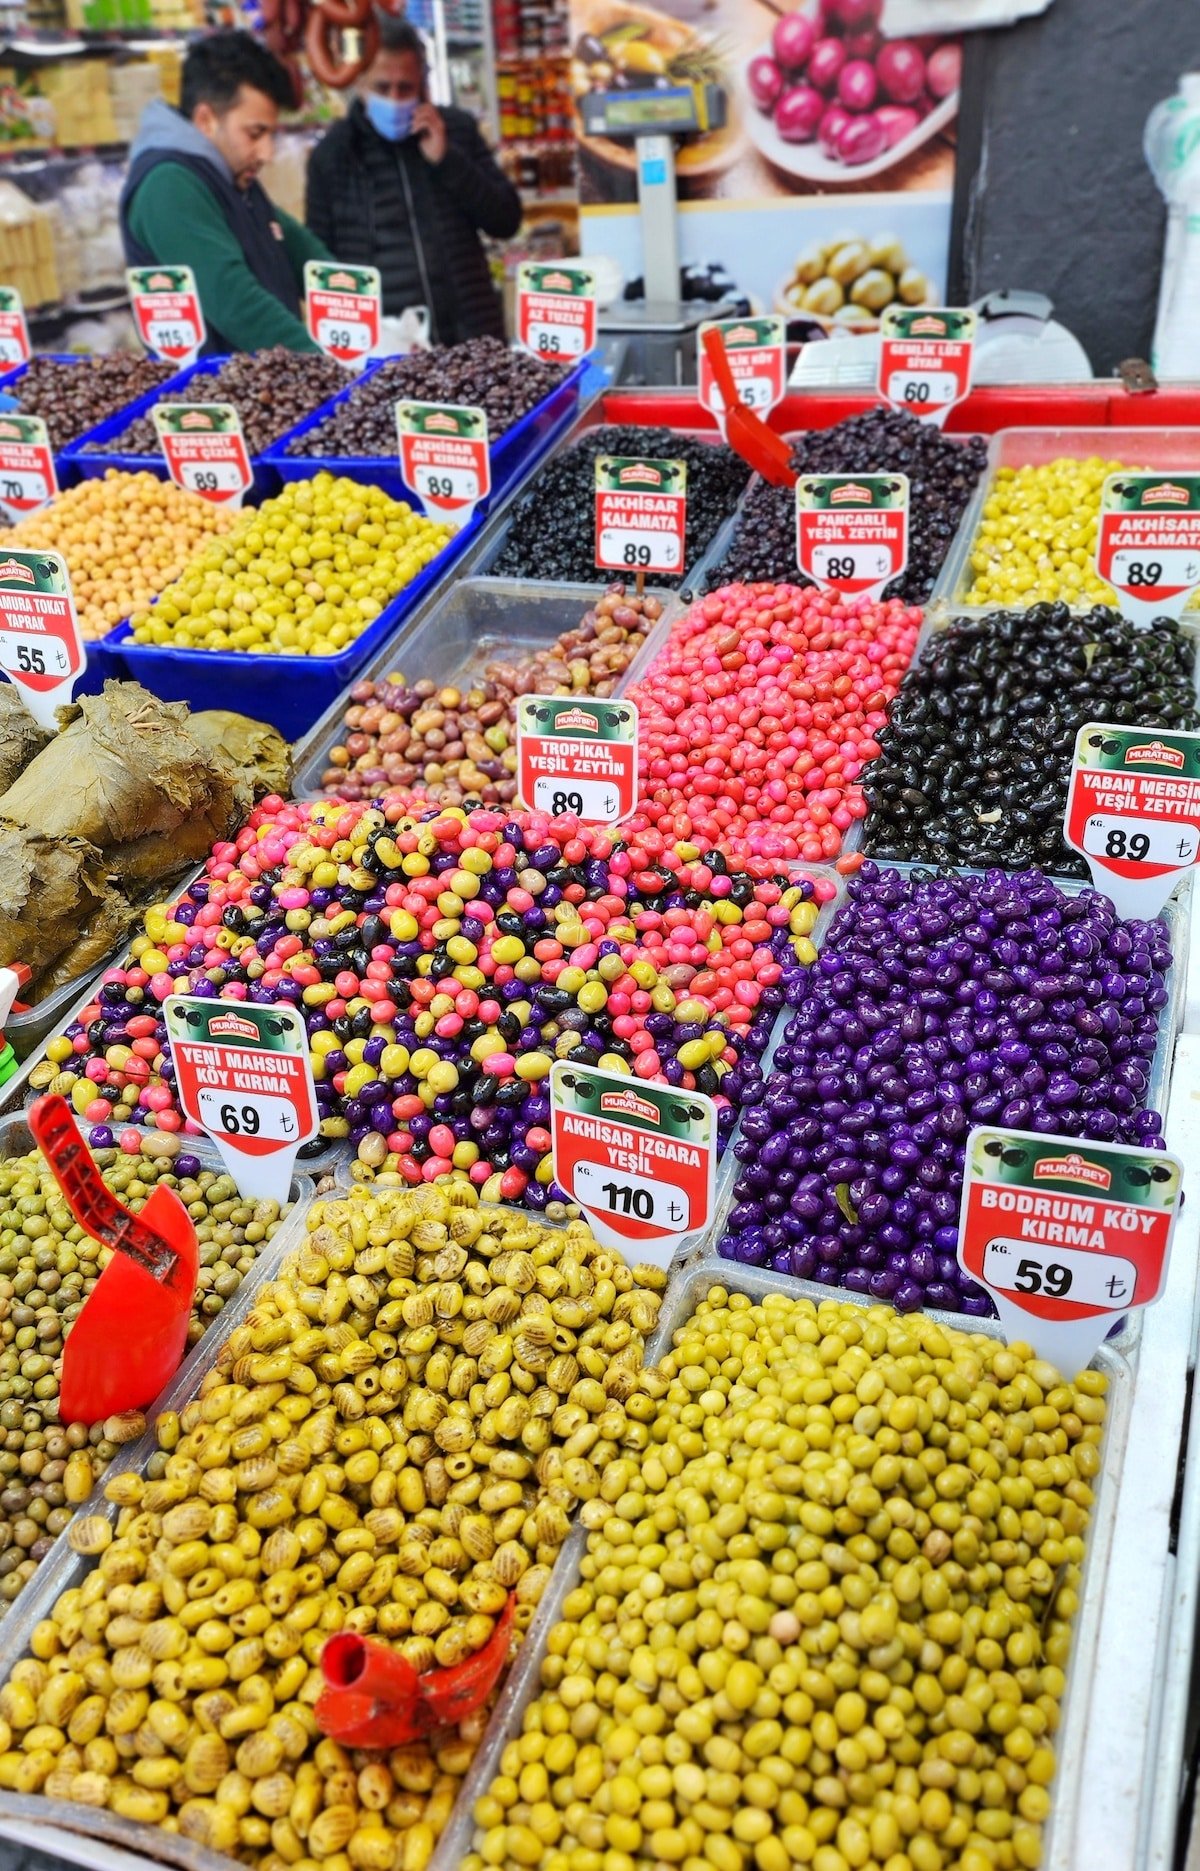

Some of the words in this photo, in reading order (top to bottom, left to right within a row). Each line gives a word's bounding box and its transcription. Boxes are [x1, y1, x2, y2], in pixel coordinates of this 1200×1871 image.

[158, 329, 184, 348] 115
[330, 329, 351, 350] 99
[538, 332, 560, 354] 85
[904, 381, 931, 403] 60
[2, 479, 23, 500] 70
[194, 471, 218, 491] 89
[427, 476, 453, 498] 89
[602, 495, 678, 513] AKHİSAR
[601, 512, 678, 530] KALAMATA
[817, 514, 888, 527] PANCARLI
[1118, 516, 1200, 532] AKHİSAR
[806, 525, 846, 543] YEŞİL
[848, 525, 899, 540] ZEYTİN
[1108, 532, 1200, 546] KALAMAT
[623, 543, 652, 567] 89
[827, 557, 856, 579] 89
[1127, 562, 1163, 587] 89
[33, 599, 66, 616] TOKAT
[5, 612, 46, 631] YAPRAK
[17, 645, 46, 675] 55
[540, 741, 613, 760] TROPİKAL
[1128, 749, 1181, 764] MURATBEY
[528, 755, 570, 774] YEŞİL
[573, 759, 625, 777] ZEYTİN
[1082, 774, 1136, 793] YABAN
[551, 791, 584, 818] 89
[1095, 791, 1140, 812] YEŞİL
[1090, 819, 1106, 828] KG.
[1105, 829, 1151, 862] 89
[211, 1022, 257, 1034] MURATBEY
[181, 1047, 222, 1066] YENİ
[225, 1052, 299, 1077] MAHSUL
[195, 1064, 229, 1086] KÖY
[233, 1071, 292, 1095] KIRMA
[200, 1093, 215, 1103] KG.
[604, 1097, 657, 1118] MURATBEY
[220, 1104, 260, 1135] 69
[563, 1116, 634, 1150] AKHİSAR
[638, 1136, 701, 1168] IZGARA
[577, 1165, 593, 1177] KG.
[607, 1147, 654, 1175] YEŞİL
[1038, 1164, 1107, 1183] MURATBEY
[602, 1182, 654, 1220] 110
[981, 1188, 1095, 1225] BODRUM
[1103, 1207, 1157, 1234] KÖY
[1021, 1218, 1106, 1250] KIRMA
[991, 1244, 1012, 1255] KG.
[1014, 1259, 1073, 1297] 59
